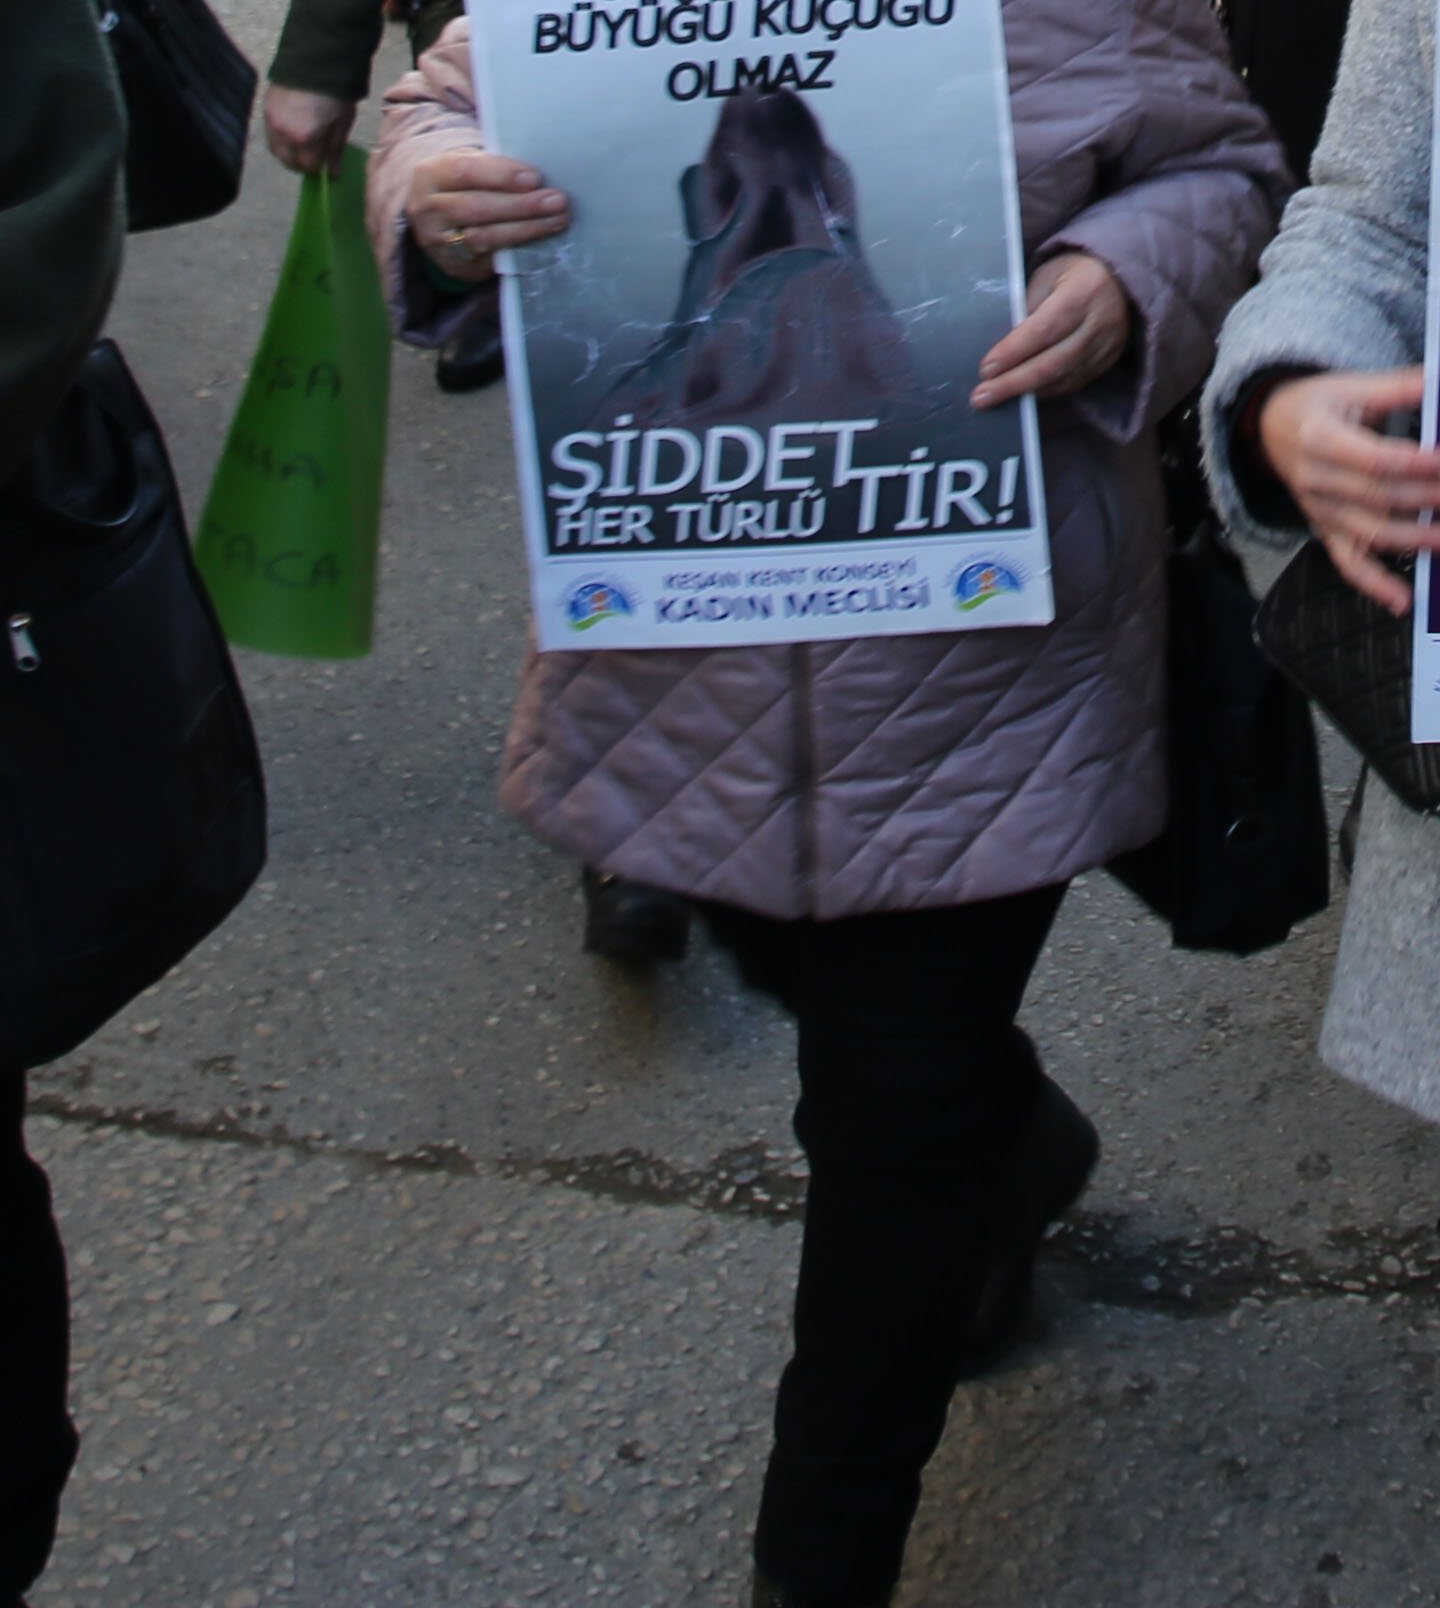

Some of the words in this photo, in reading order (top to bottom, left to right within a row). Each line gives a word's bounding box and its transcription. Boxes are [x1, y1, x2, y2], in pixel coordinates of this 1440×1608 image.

[665, 48, 837, 102] OLMAZ
[546, 412, 880, 512] ŞİDDET
[849, 446, 1022, 534] TİR!
[554, 502, 655, 548] HER
[664, 487, 827, 542] TÜRLÜ
[655, 591, 776, 625] KADIN
[781, 578, 932, 618] MECLİSİ
[744, 565, 809, 588] KENT
